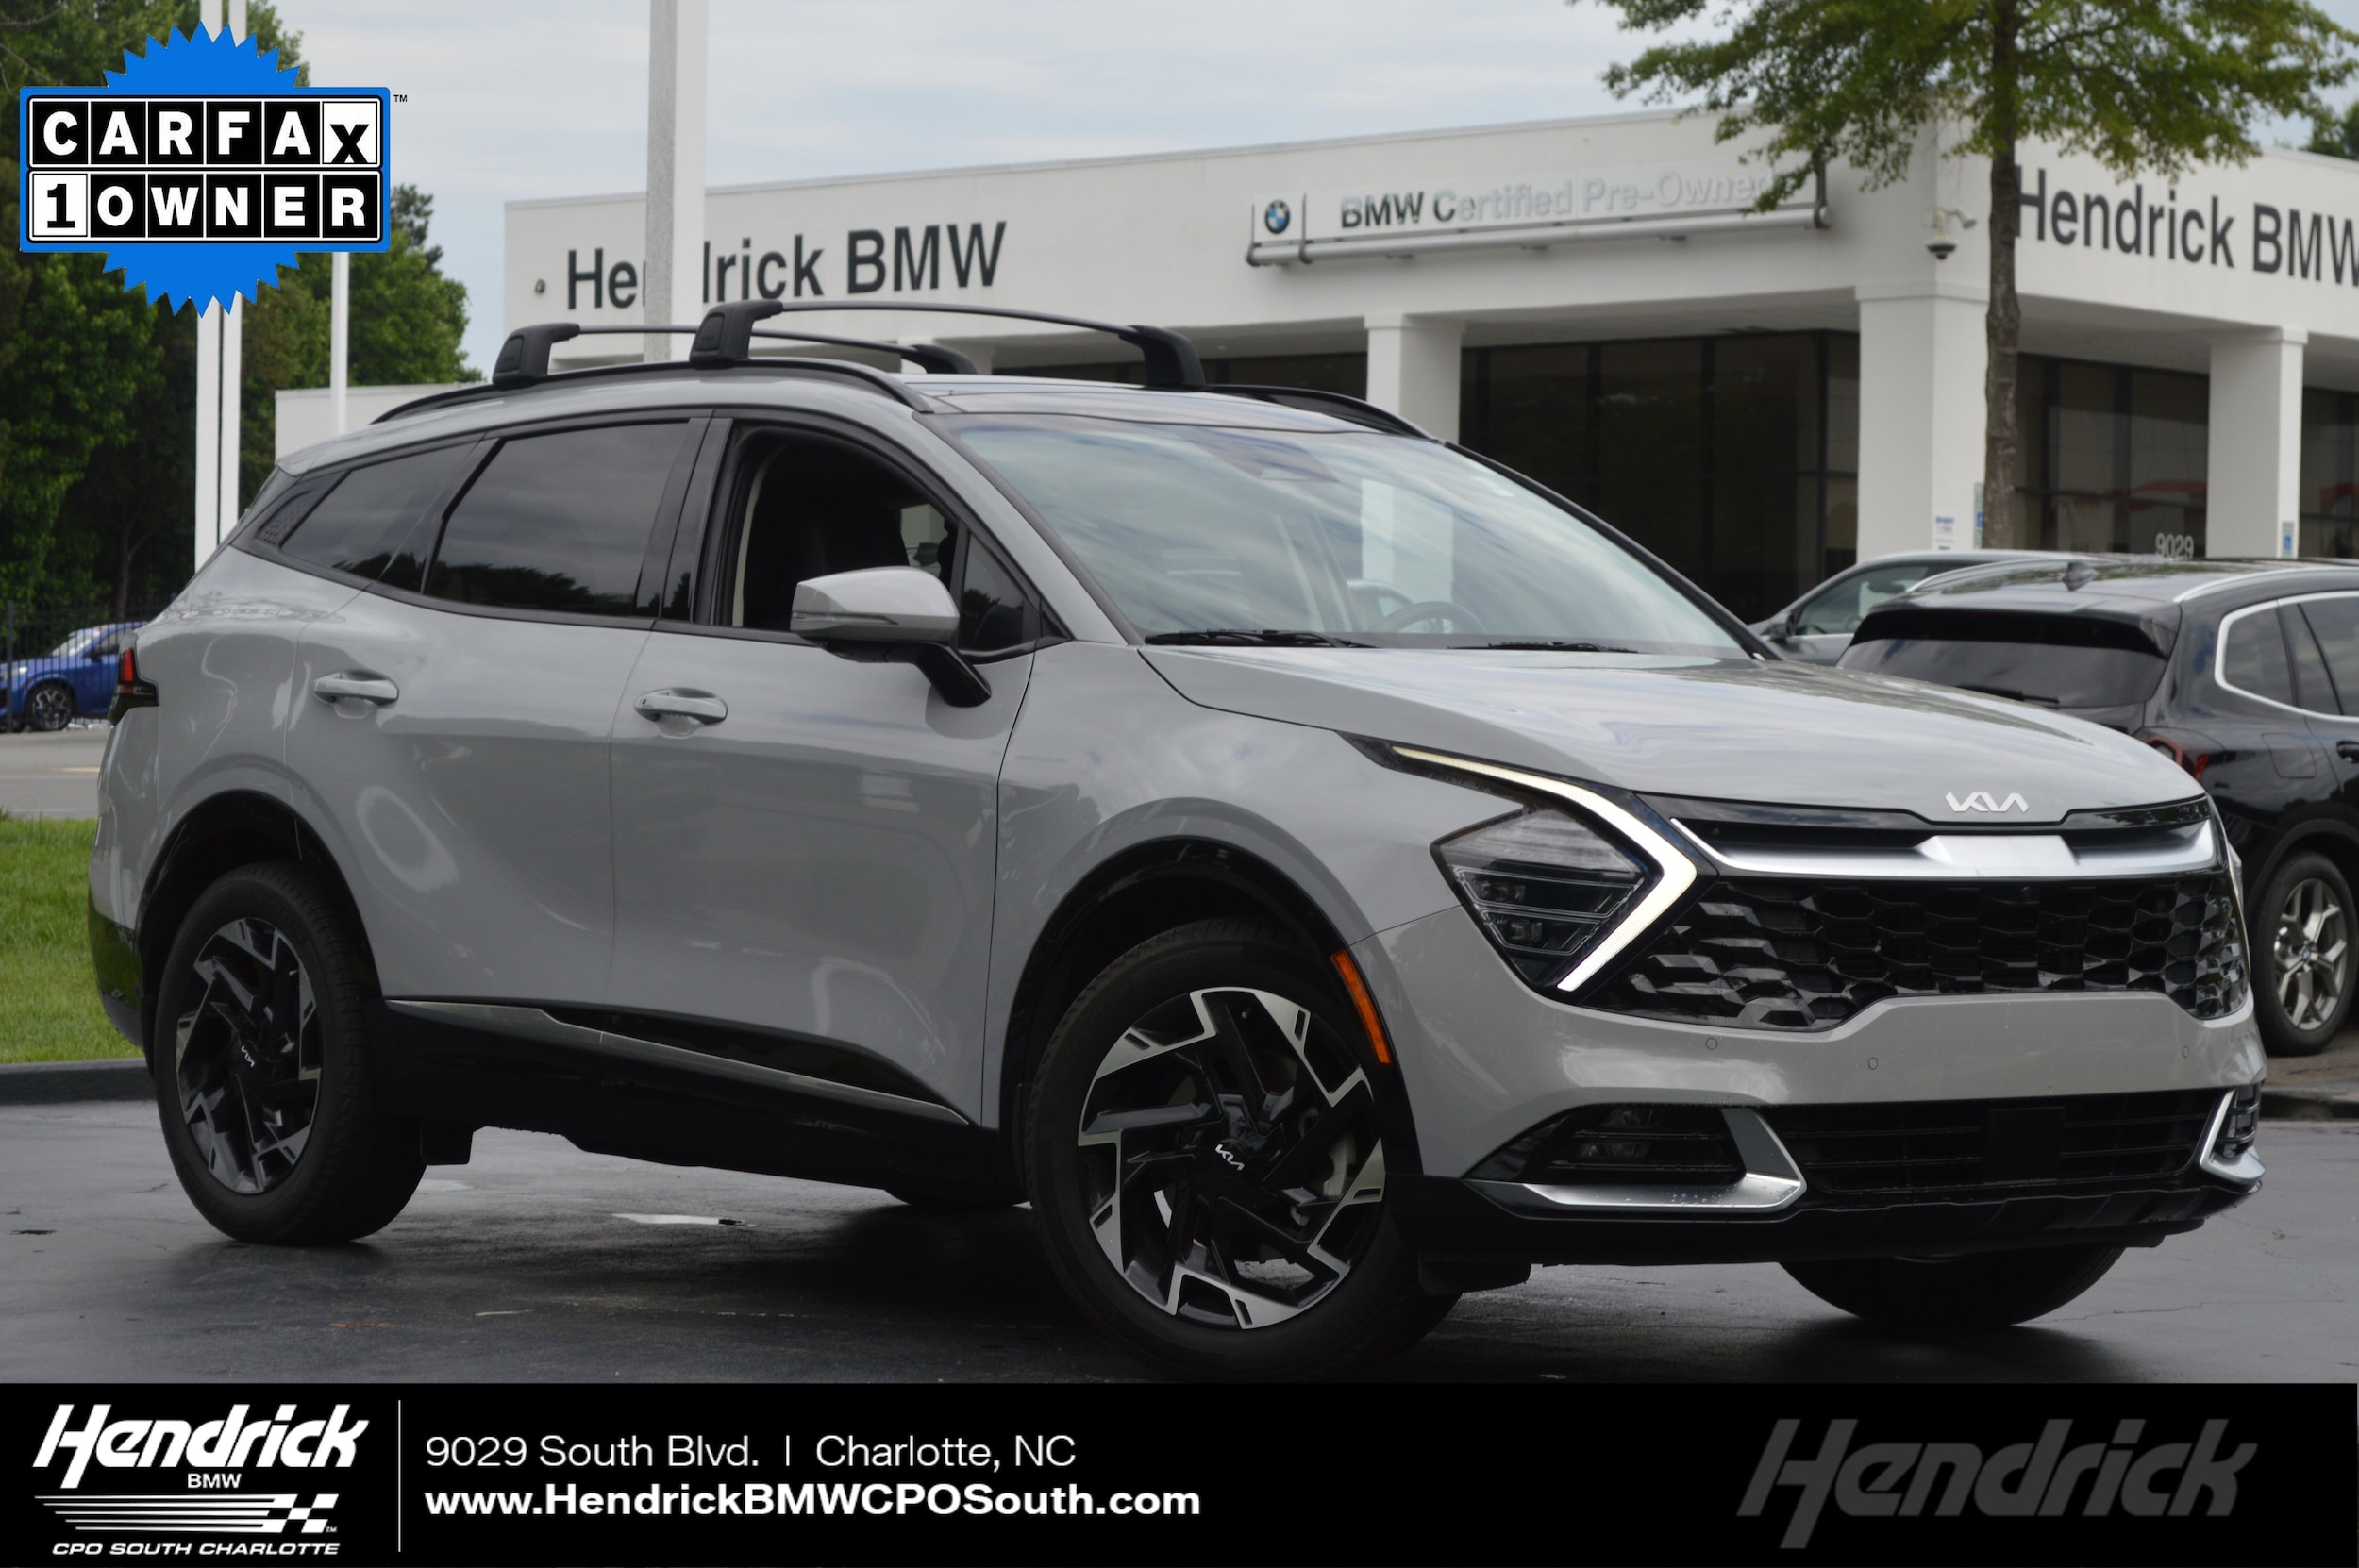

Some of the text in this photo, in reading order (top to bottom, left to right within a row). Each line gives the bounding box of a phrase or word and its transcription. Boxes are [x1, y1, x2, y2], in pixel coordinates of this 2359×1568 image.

[1341, 191, 1424, 228] BMW
[1432, 180, 1574, 222] Certified
[2014, 163, 2359, 287] Hendrick BMW
[847, 221, 1006, 294] BMW
[1945, 792, 2030, 813] KIA
